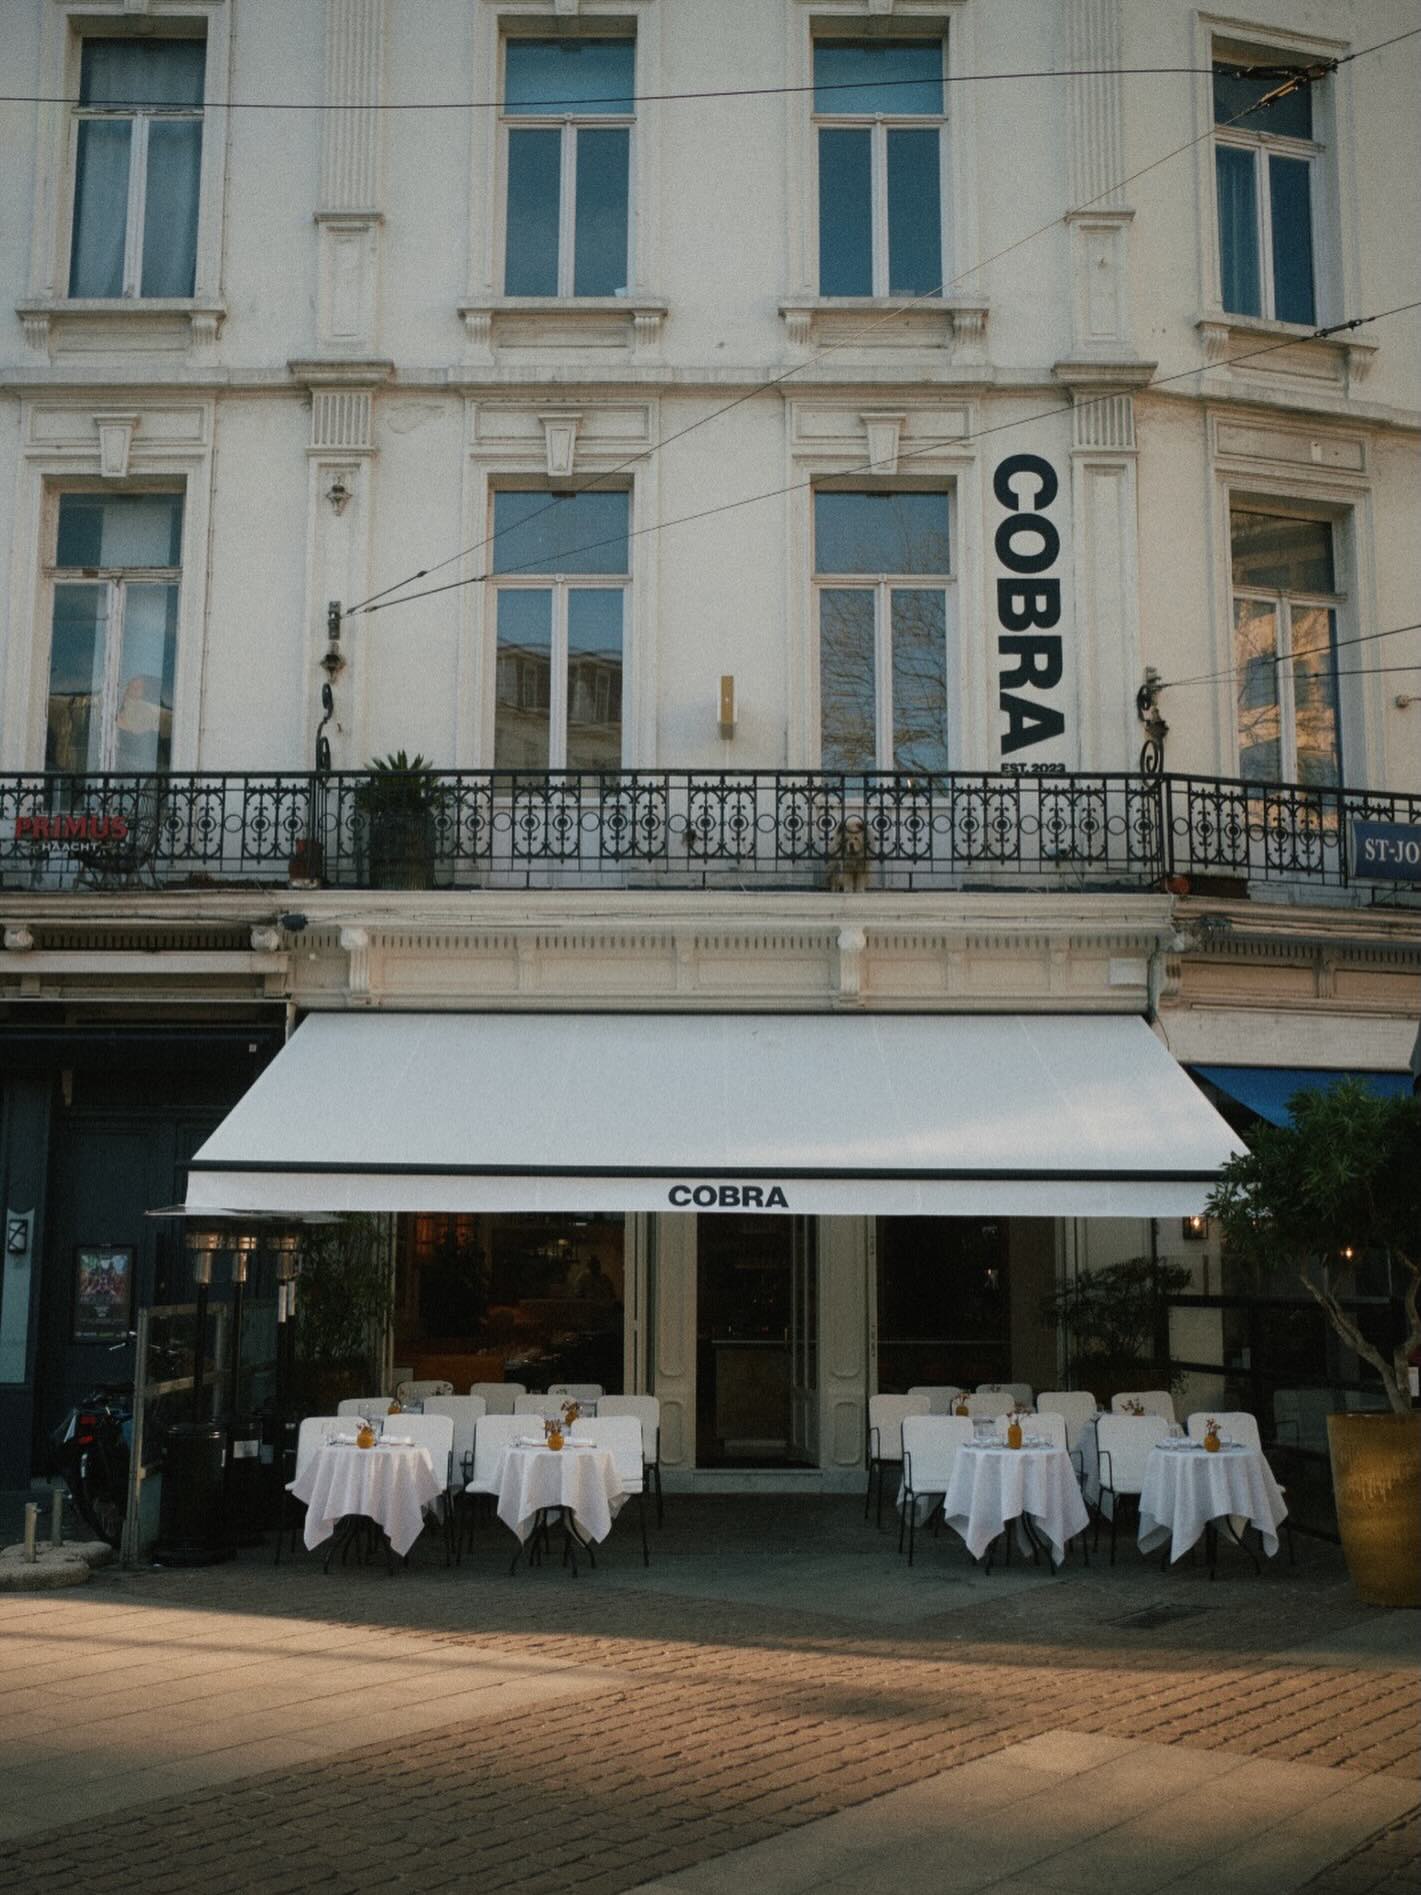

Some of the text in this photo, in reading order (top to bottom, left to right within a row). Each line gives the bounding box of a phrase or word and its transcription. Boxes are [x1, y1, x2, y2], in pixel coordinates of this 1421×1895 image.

[993, 453, 1065, 755] COBRA
[1001, 763, 1066, 774] EST. 2023
[16, 815, 129, 840] PRIMUS
[41, 842, 98, 852] HAACHT
[668, 1185, 789, 1208] COBRA
